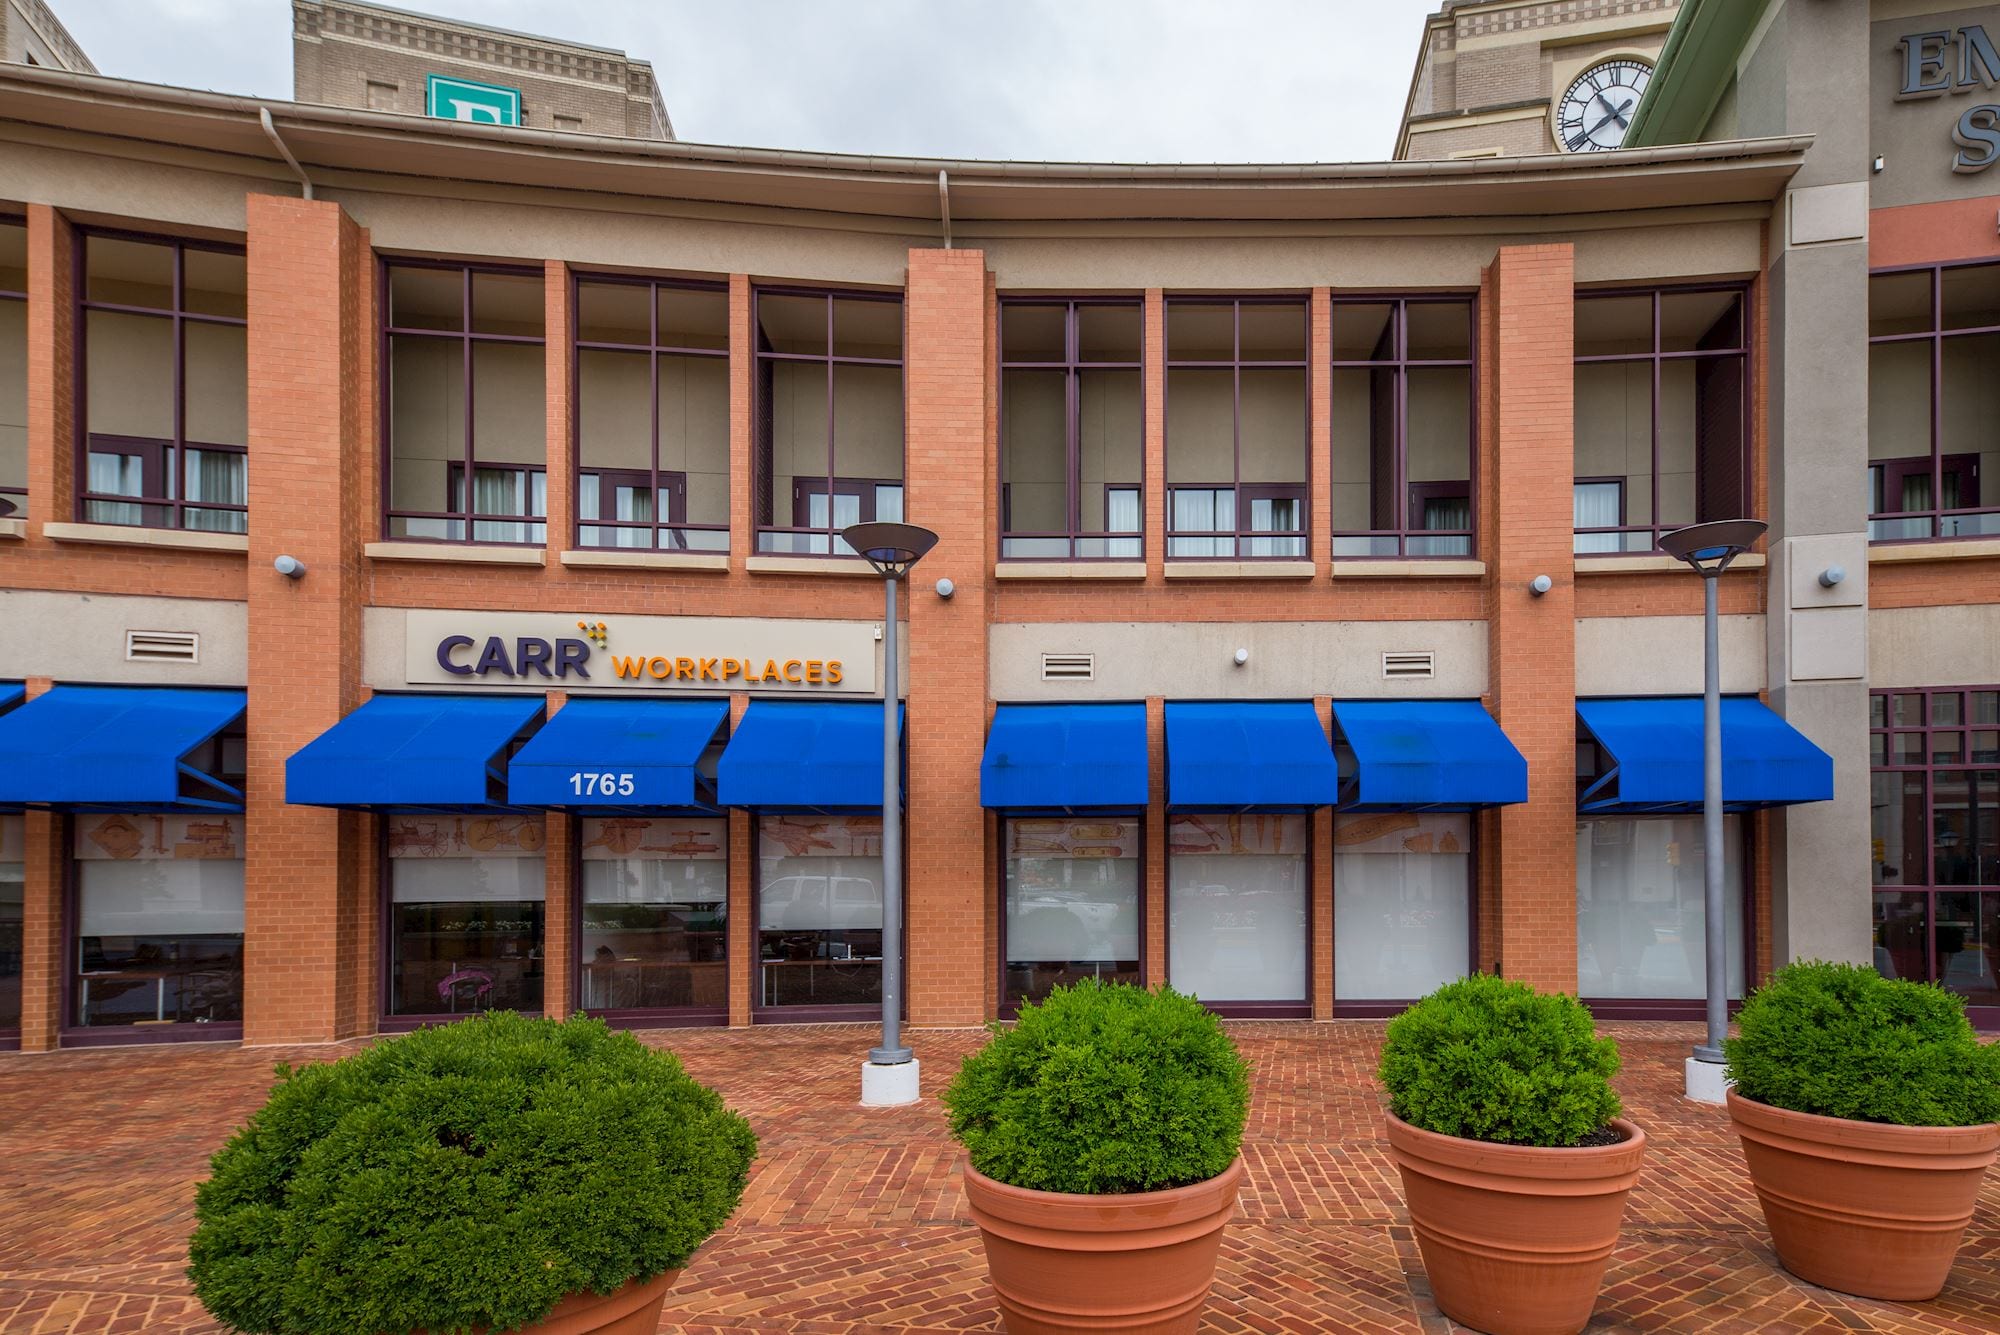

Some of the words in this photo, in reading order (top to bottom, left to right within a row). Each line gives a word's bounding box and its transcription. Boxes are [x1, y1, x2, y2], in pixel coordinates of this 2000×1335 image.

[436, 635, 591, 677] CARR
[611, 655, 843, 683] WORKPLACES
[569, 772, 635, 796] 1765
